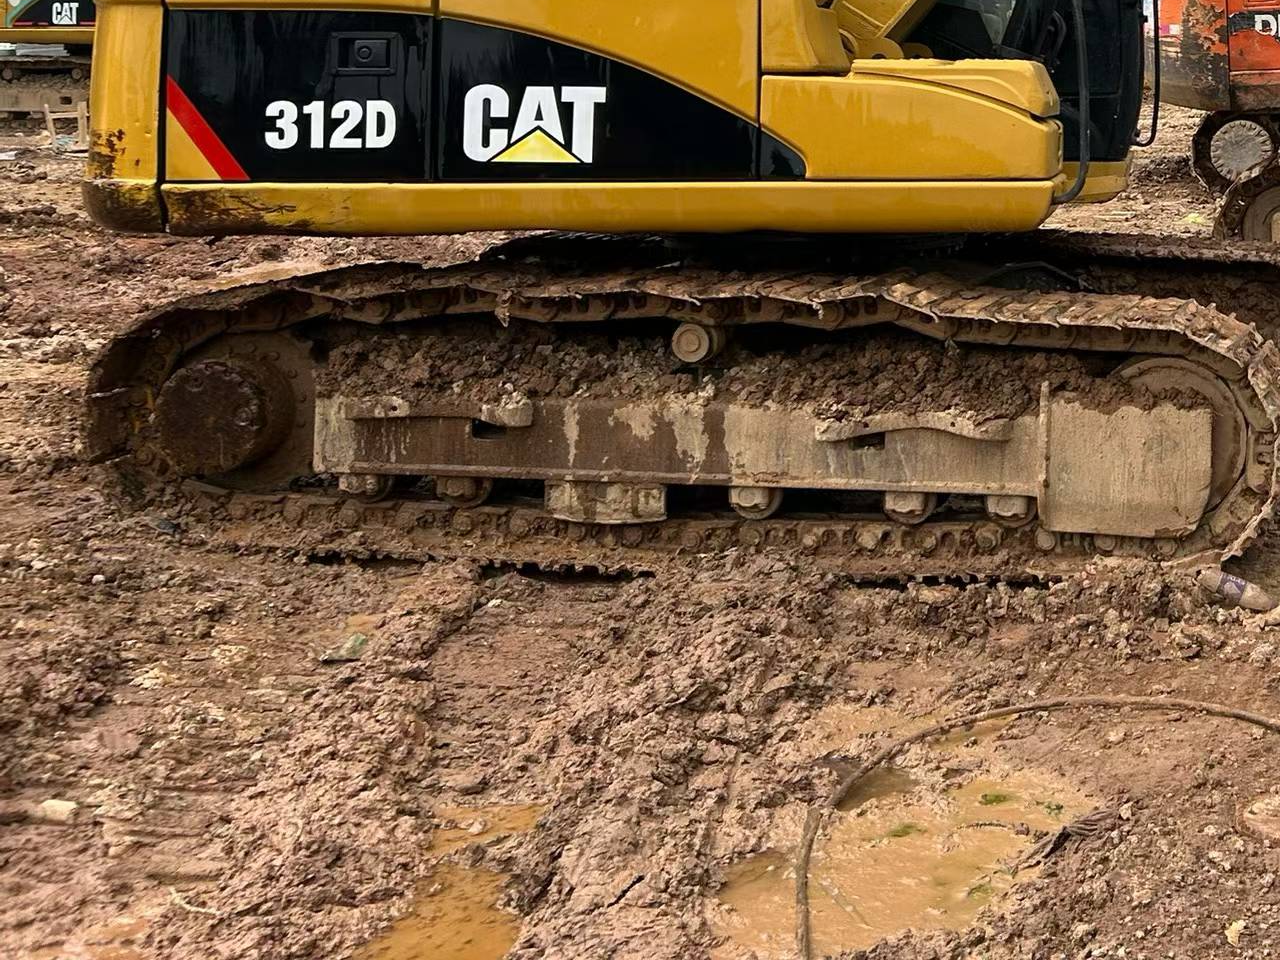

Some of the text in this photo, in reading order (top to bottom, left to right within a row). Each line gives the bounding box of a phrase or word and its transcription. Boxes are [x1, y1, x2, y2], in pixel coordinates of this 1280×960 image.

[52, 2, 79, 25] CAT
[264, 100, 397, 150] 312D
[463, 83, 607, 163] CAT
